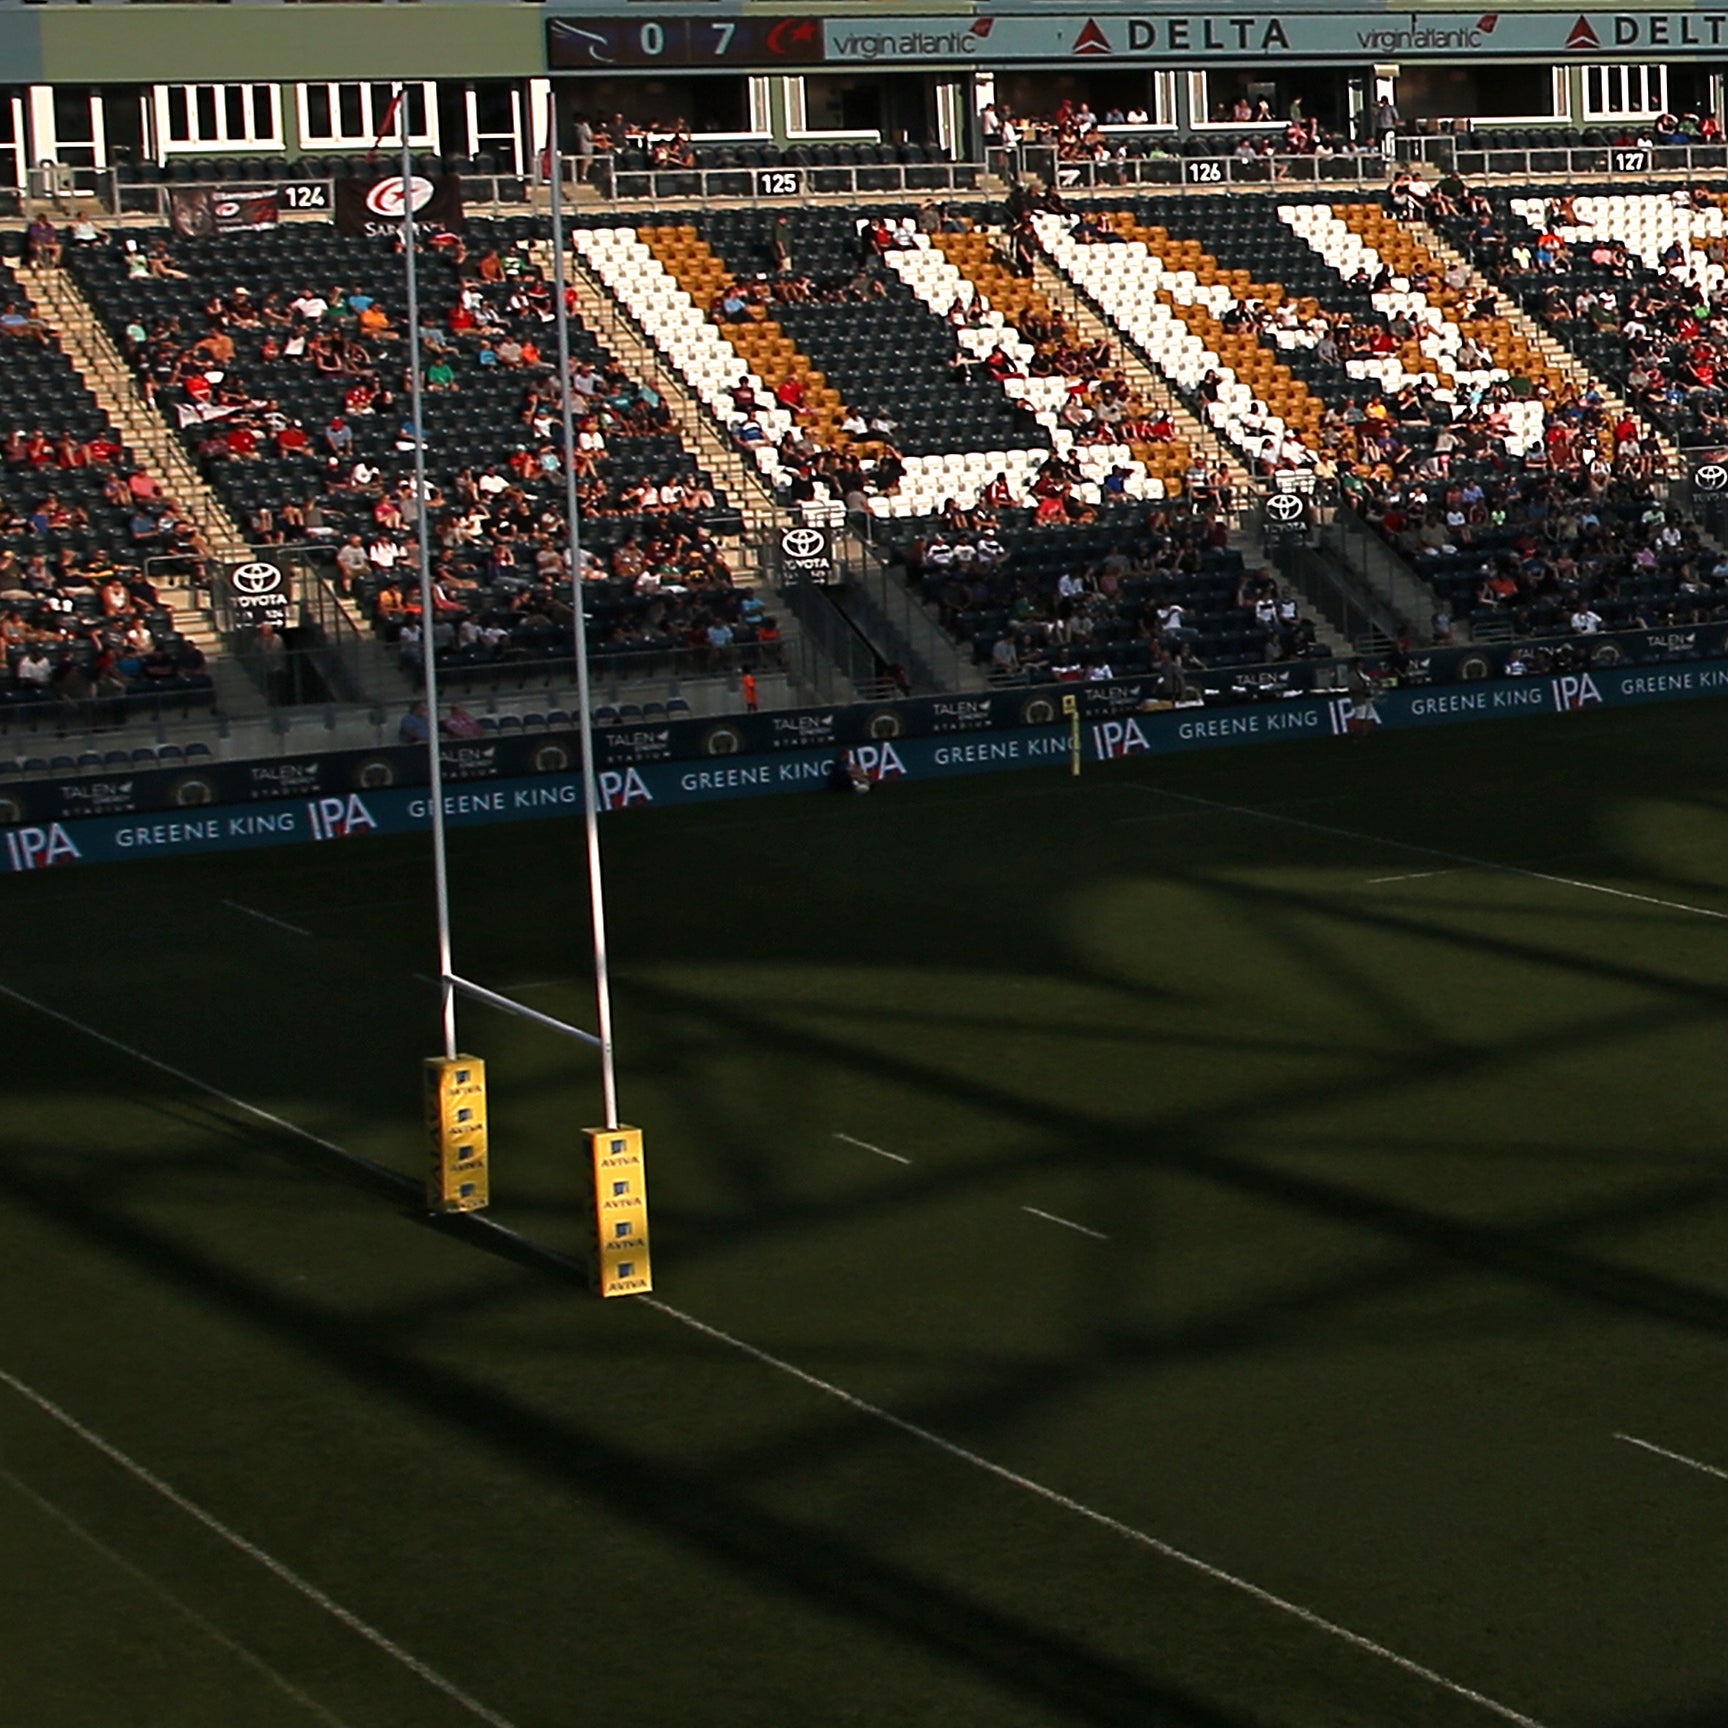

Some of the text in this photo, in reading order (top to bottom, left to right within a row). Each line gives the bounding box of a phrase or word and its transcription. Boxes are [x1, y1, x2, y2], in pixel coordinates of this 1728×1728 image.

[640, 23, 735, 55] 0 7
[1128, 19, 1289, 50] DELTA
[1616, 152, 1644, 171] 127
[1189, 162, 1222, 183] 126
[762, 173, 797, 194] 125
[286, 186, 325, 207] 124
[1411, 671, 1603, 716] GREENE KING IPA
[1621, 676, 1693, 696] GREENE
[933, 702, 979, 716] TALEN
[773, 715, 821, 730] TALEN
[1179, 715, 1259, 740] GREENE
[1267, 710, 1319, 731] KING
[606, 731, 657, 747] TALEN
[934, 740, 1019, 766] GREENE
[1092, 717, 1152, 761] IPA
[440, 747, 481, 763] ALEN
[251, 762, 304, 781] TALEN
[681, 764, 771, 792] GREENE
[59, 782, 118, 799] TALEN
[514, 784, 577, 812] KING
[595, 766, 653, 813] PA
[115, 792, 379, 848] GREENE KING IPA
[5, 821, 83, 872] IPA
[601, 1155, 640, 1168] AVIVA
[603, 1197, 642, 1209] AVIVA
[606, 1237, 645, 1250] AVIVA
[608, 1278, 648, 1291] AVIVA
